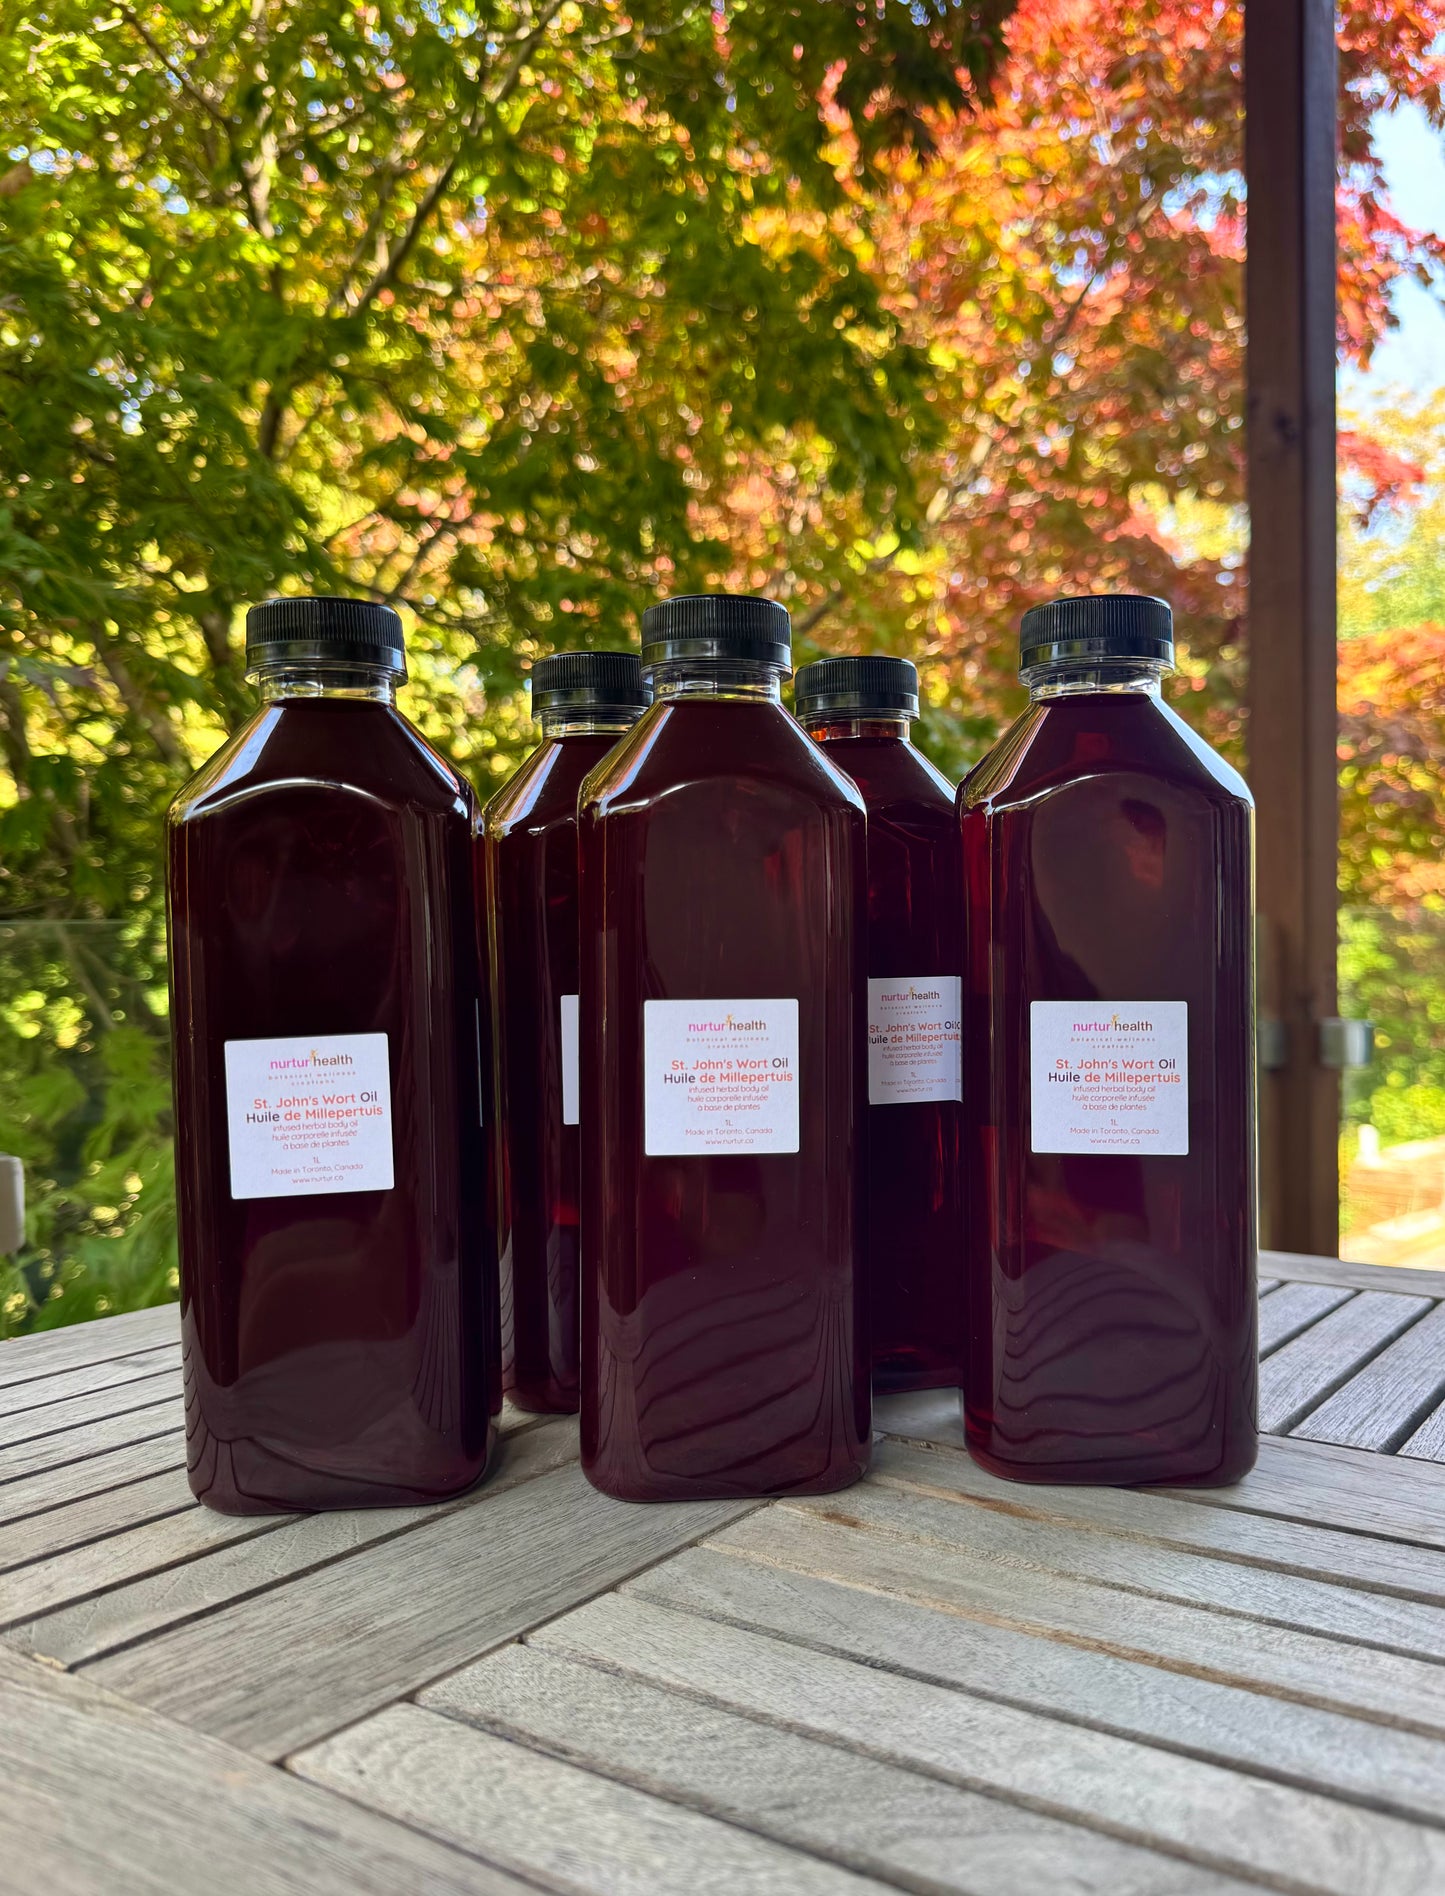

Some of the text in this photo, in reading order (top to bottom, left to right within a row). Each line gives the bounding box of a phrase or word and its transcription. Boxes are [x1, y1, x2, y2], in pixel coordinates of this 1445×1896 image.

[911, 991, 940, 1000] health
[688, 1020, 766, 1032] nurtur health
[870, 1025, 883, 1033] St.
[886, 1024, 915, 1032] John's
[918, 1022, 941, 1031] Wort
[1073, 1021, 1153, 1032] nurtur health
[891, 1035, 902, 1043] de
[270, 1055, 353, 1069] nurtur health
[672, 1058, 788, 1070] St. John's Wort Oil
[1056, 1059, 1175, 1069] St. John's Wort Oil
[664, 1071, 792, 1084] Huile de Millepertuis
[1049, 1072, 1180, 1084] Huile de Millepertuis
[741, 1085, 759, 1093] body
[254, 1091, 377, 1109] St. John's Wort Oil
[706, 1095, 741, 1103] corporelle
[742, 1093, 768, 1101] infusée
[247, 1105, 383, 1123] Huile de Millepertuis
[302, 1122, 326, 1130] herbal
[328, 1121, 349, 1129] body
[291, 1132, 329, 1141] corporelle
[331, 1129, 357, 1137] infusée
[322, 1140, 349, 1148] plantes
[335, 1163, 363, 1171] Canada
